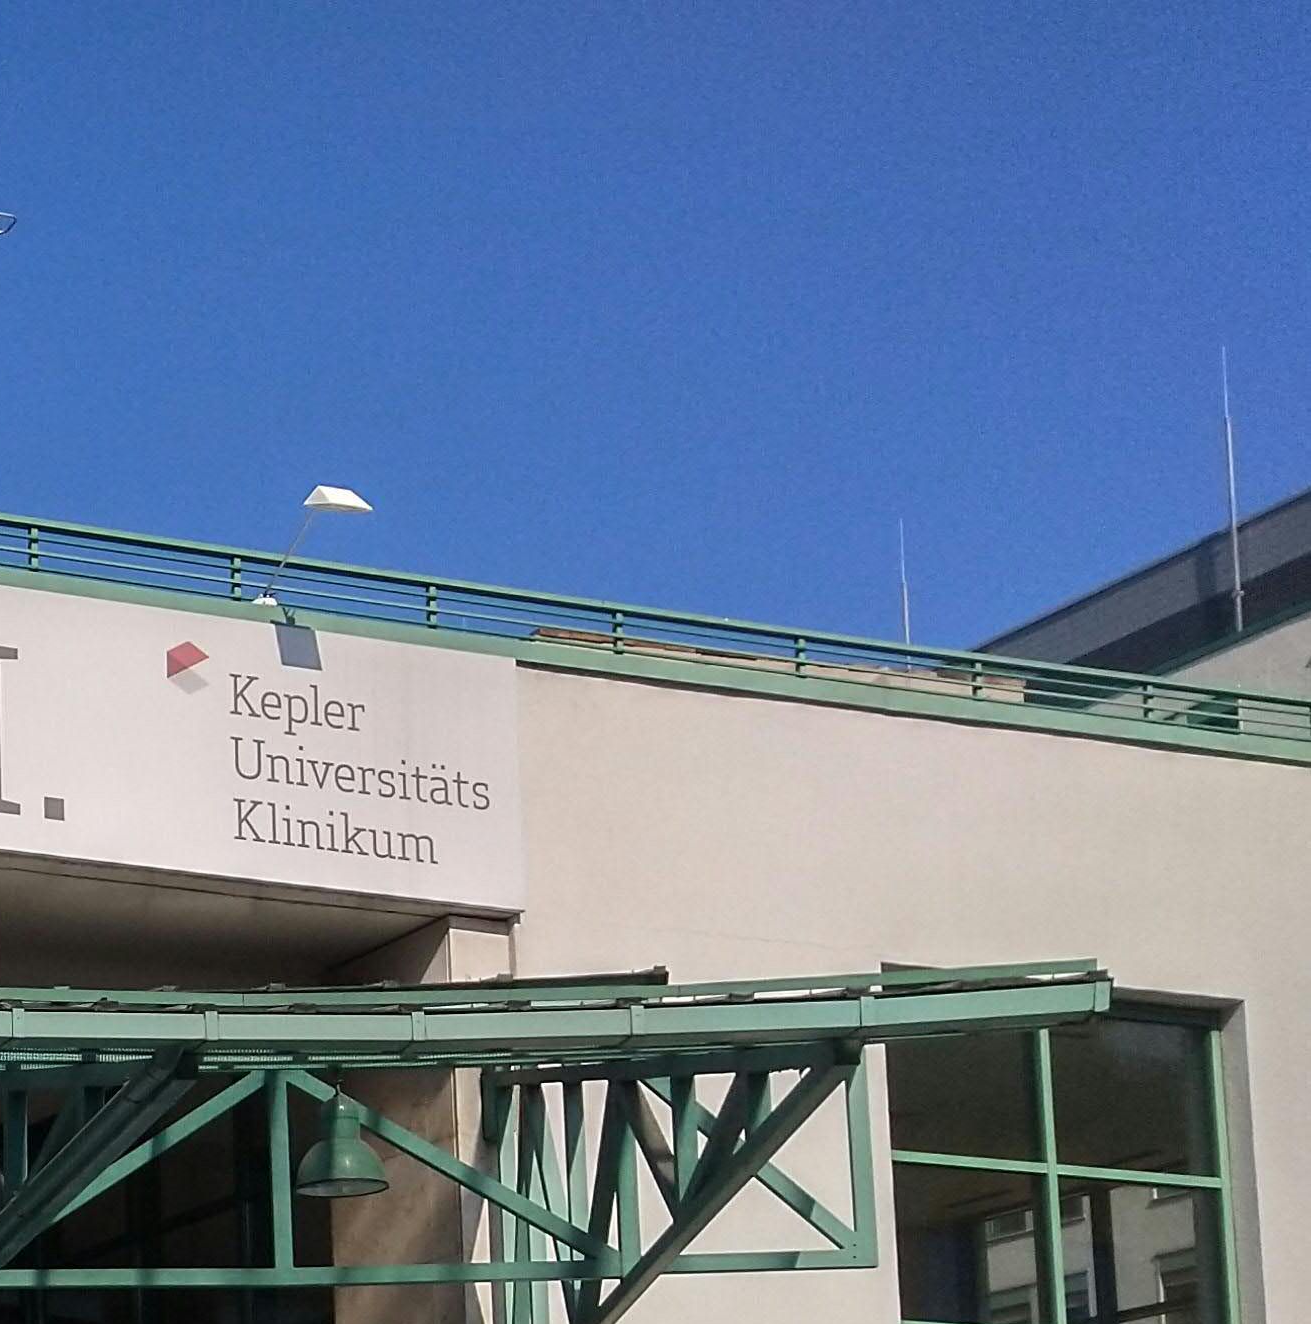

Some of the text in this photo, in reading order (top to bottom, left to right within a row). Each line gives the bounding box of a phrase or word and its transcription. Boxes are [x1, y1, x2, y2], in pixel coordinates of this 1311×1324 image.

[228, 673, 366, 736] Kepler
[230, 736, 491, 811] Universitäts
[233, 797, 439, 865] Klinikum
